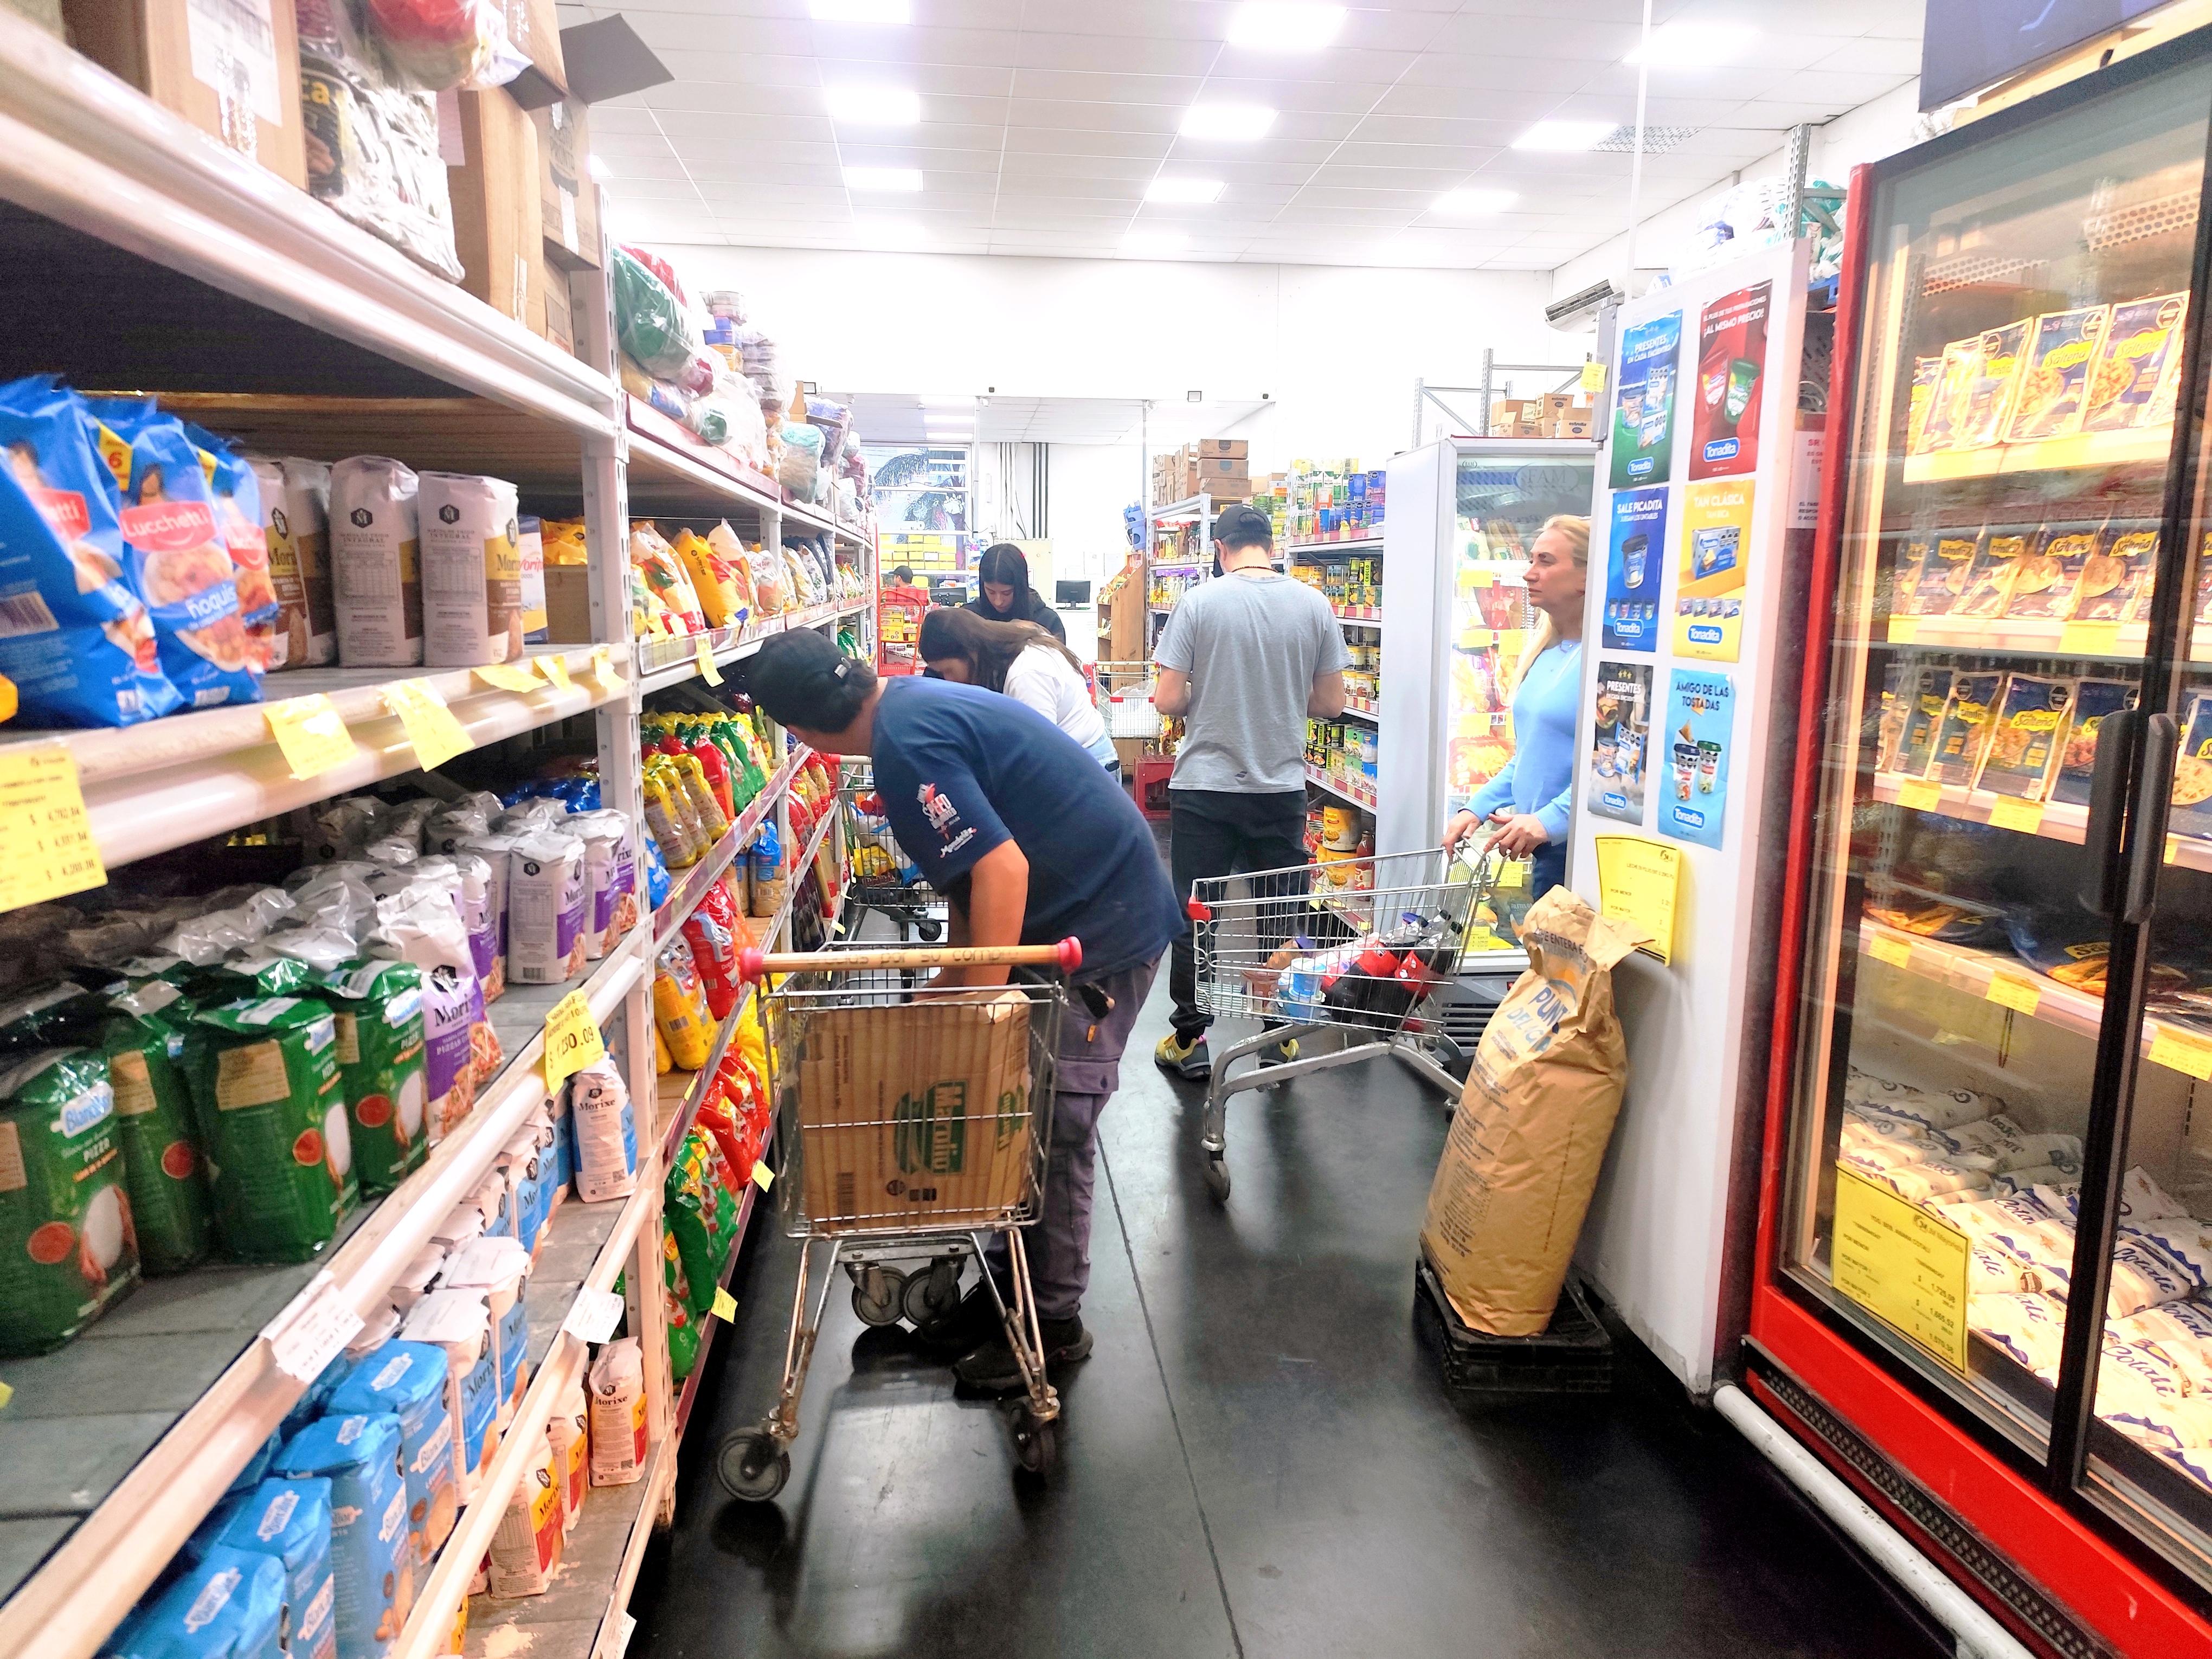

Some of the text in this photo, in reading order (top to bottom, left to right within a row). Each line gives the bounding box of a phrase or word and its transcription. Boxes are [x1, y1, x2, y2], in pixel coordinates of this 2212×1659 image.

[1715, 318, 1737, 332] MISMO
[1737, 308, 1764, 324] PRECIO!
[1635, 333, 1668, 354] PRESENTES
[1707, 443, 1737, 458] Tonadita
[1527, 469, 1566, 484] FAM
[1617, 499, 1663, 514] SALE PICADITA
[1694, 492, 1745, 509] TAN CLÁSICA
[122, 506, 210, 538] Lucchetti
[1606, 680, 1642, 694] PRESENTES
[1676, 681, 1729, 697] AMIGO DE LAS
[1682, 696, 1721, 711] TOSTADAS
[2015, 715, 2053, 728] Salteña
[1550, 933, 1577, 951] ENTERA
[578, 1097, 616, 1113] Morixe
[2113, 1248, 2176, 1294] Cotali
[2101, 1346, 2176, 1398] Cotali
